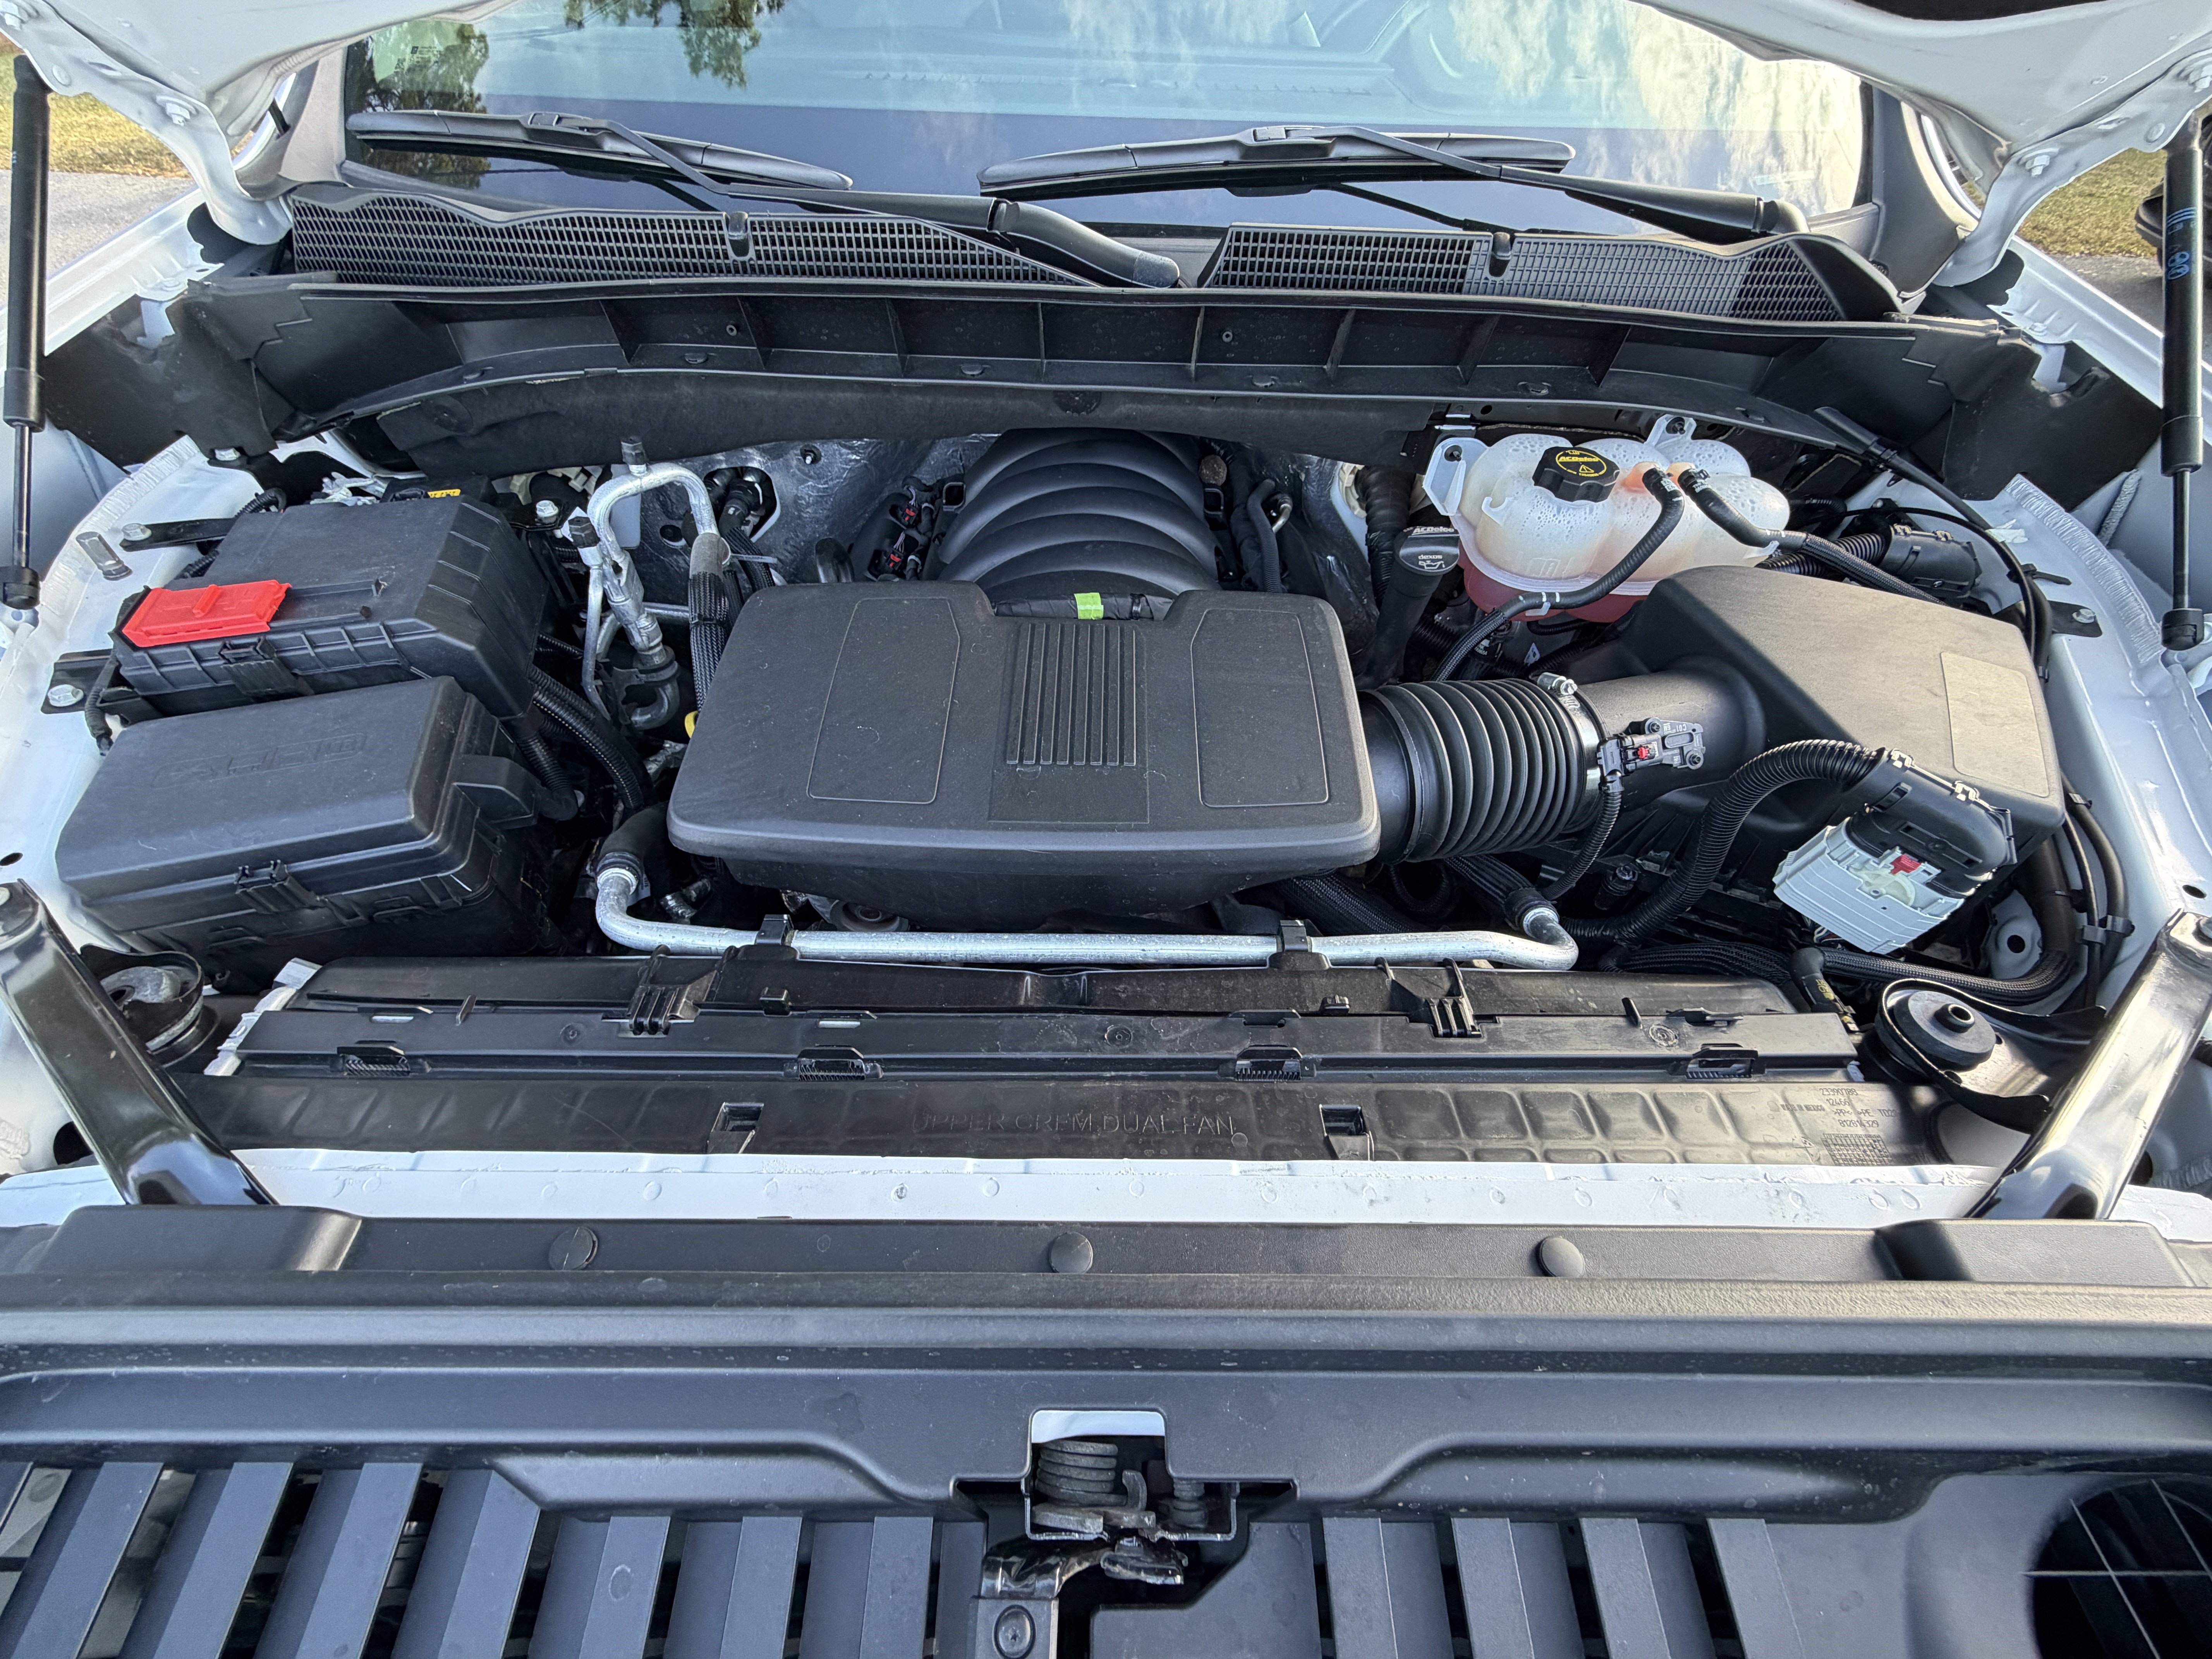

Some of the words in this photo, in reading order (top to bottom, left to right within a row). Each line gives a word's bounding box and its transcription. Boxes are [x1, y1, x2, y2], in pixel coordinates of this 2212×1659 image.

[912, 1113, 1005, 1132] UPPER
[1103, 1114, 1175, 1134] DUAL
[1183, 1115, 1233, 1135] FAN
